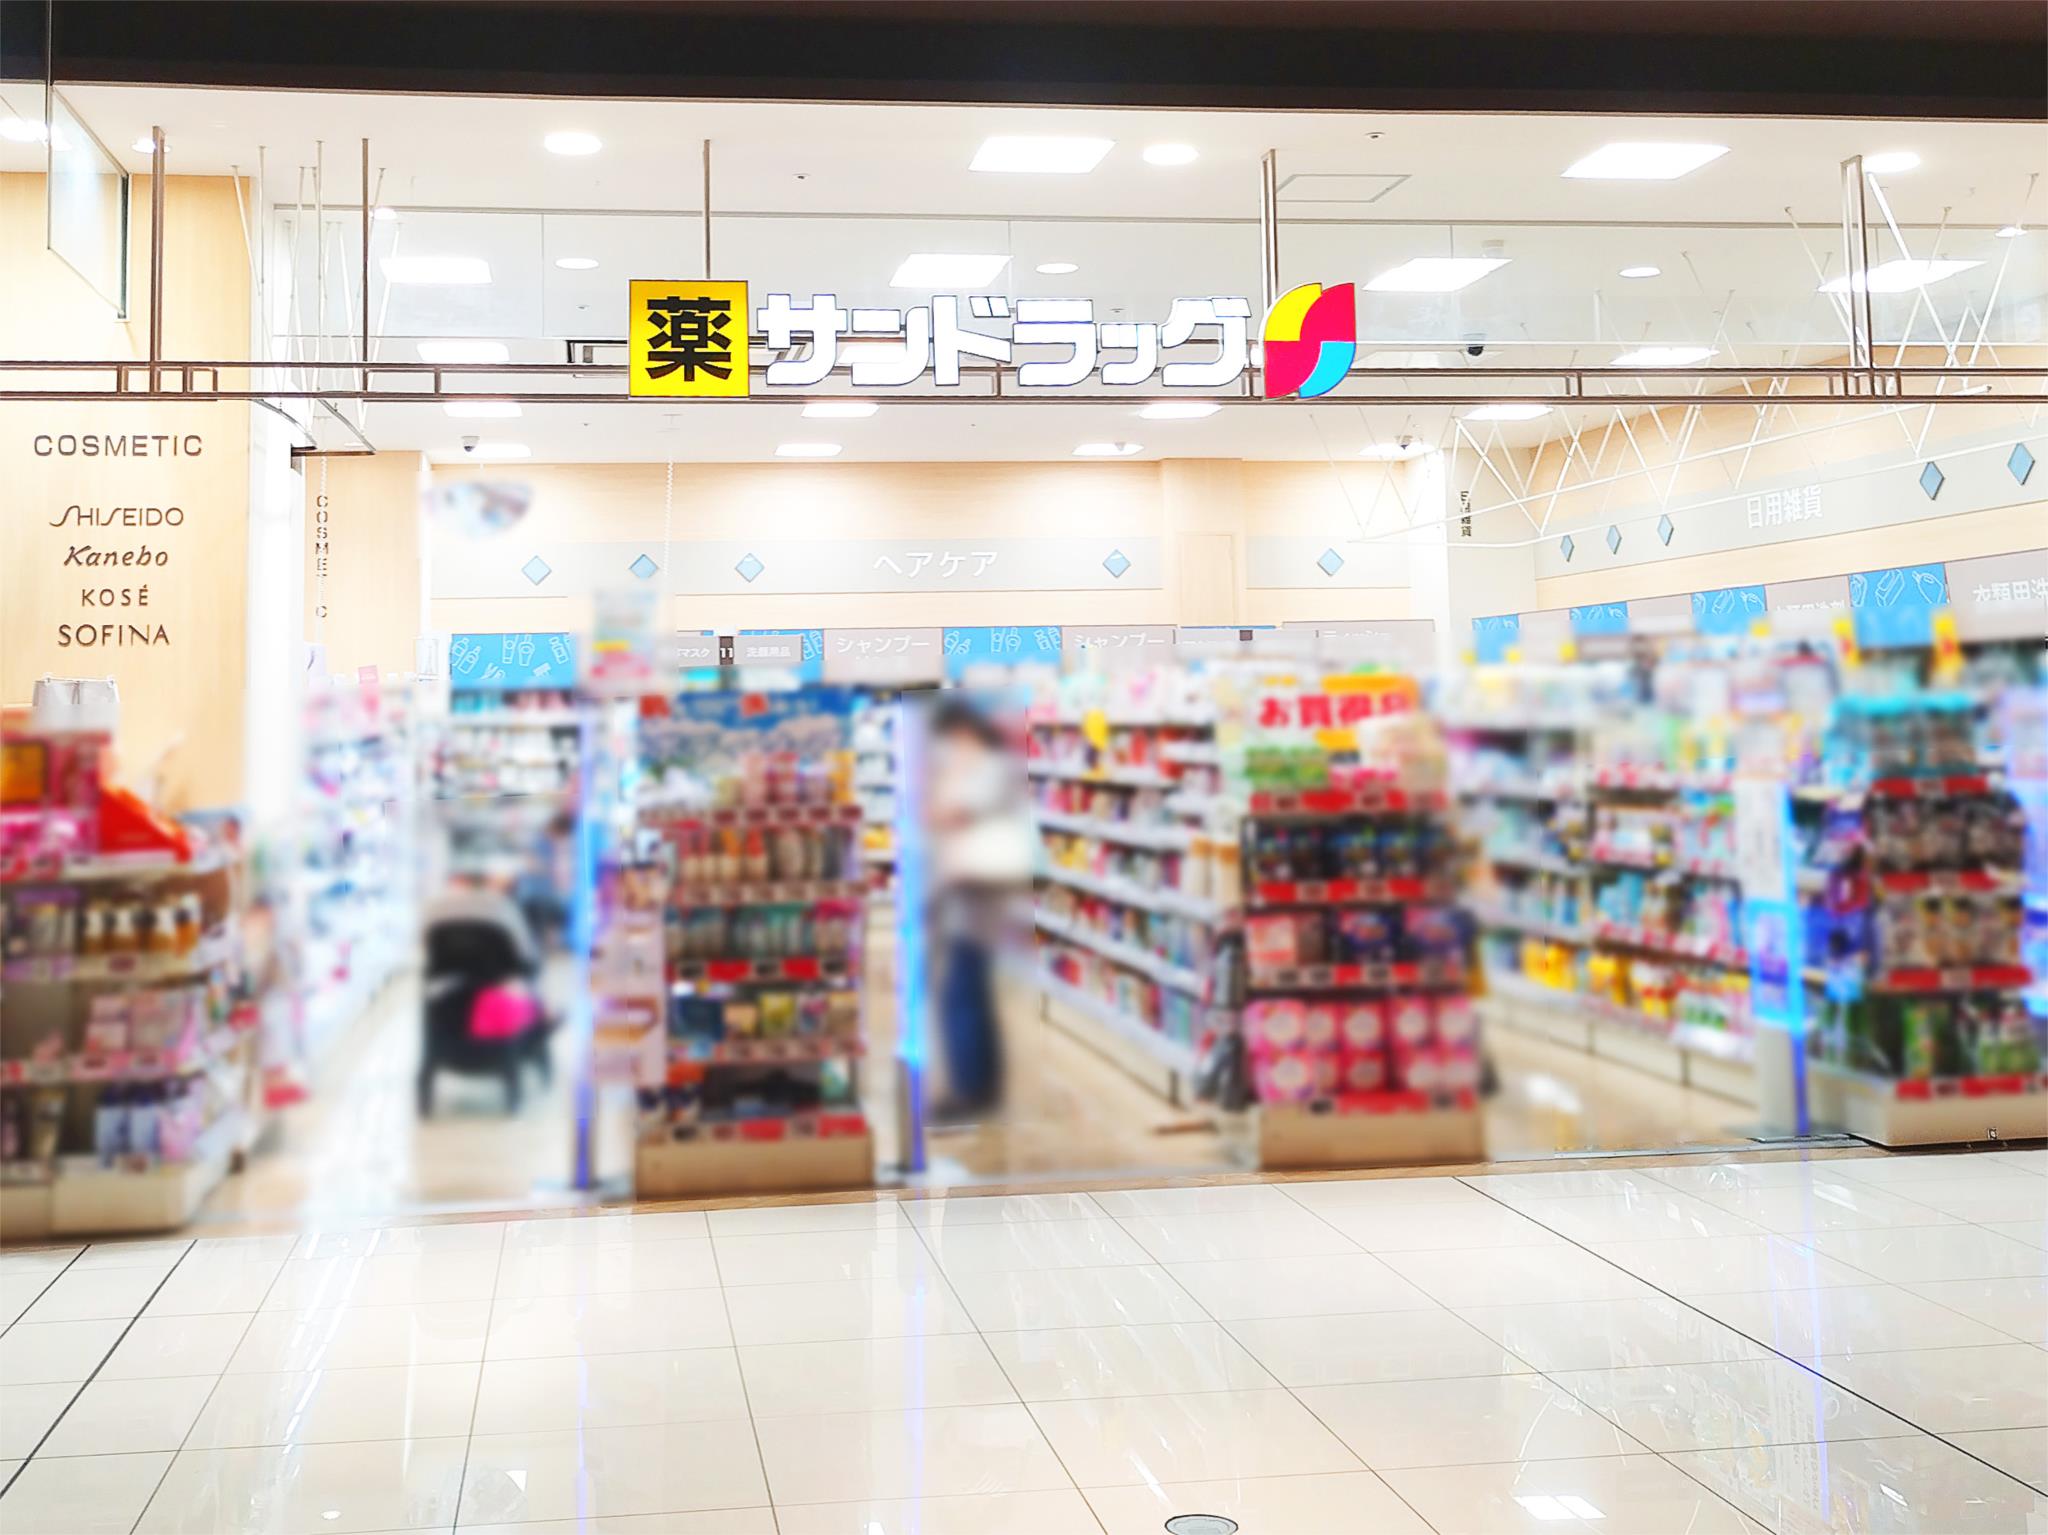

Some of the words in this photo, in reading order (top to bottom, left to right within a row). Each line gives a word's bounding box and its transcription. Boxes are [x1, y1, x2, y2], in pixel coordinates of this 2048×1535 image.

[646, 296, 733, 382] 薬
[757, 294, 1251, 386] サンドラッグ
[34, 434, 203, 457] COSMETIC
[49, 504, 185, 528] SHISEIDO
[1746, 485, 1823, 528] 日用雑貨
[63, 545, 169, 567] Kanebo
[315, 495, 329, 618] COSMEC
[872, 551, 999, 579] ヘアケア
[81, 584, 150, 608] KOSÉ
[57, 623, 171, 648] SOFINA
[836, 636, 930, 655] シャンプー
[719, 646, 734, 659] 11
